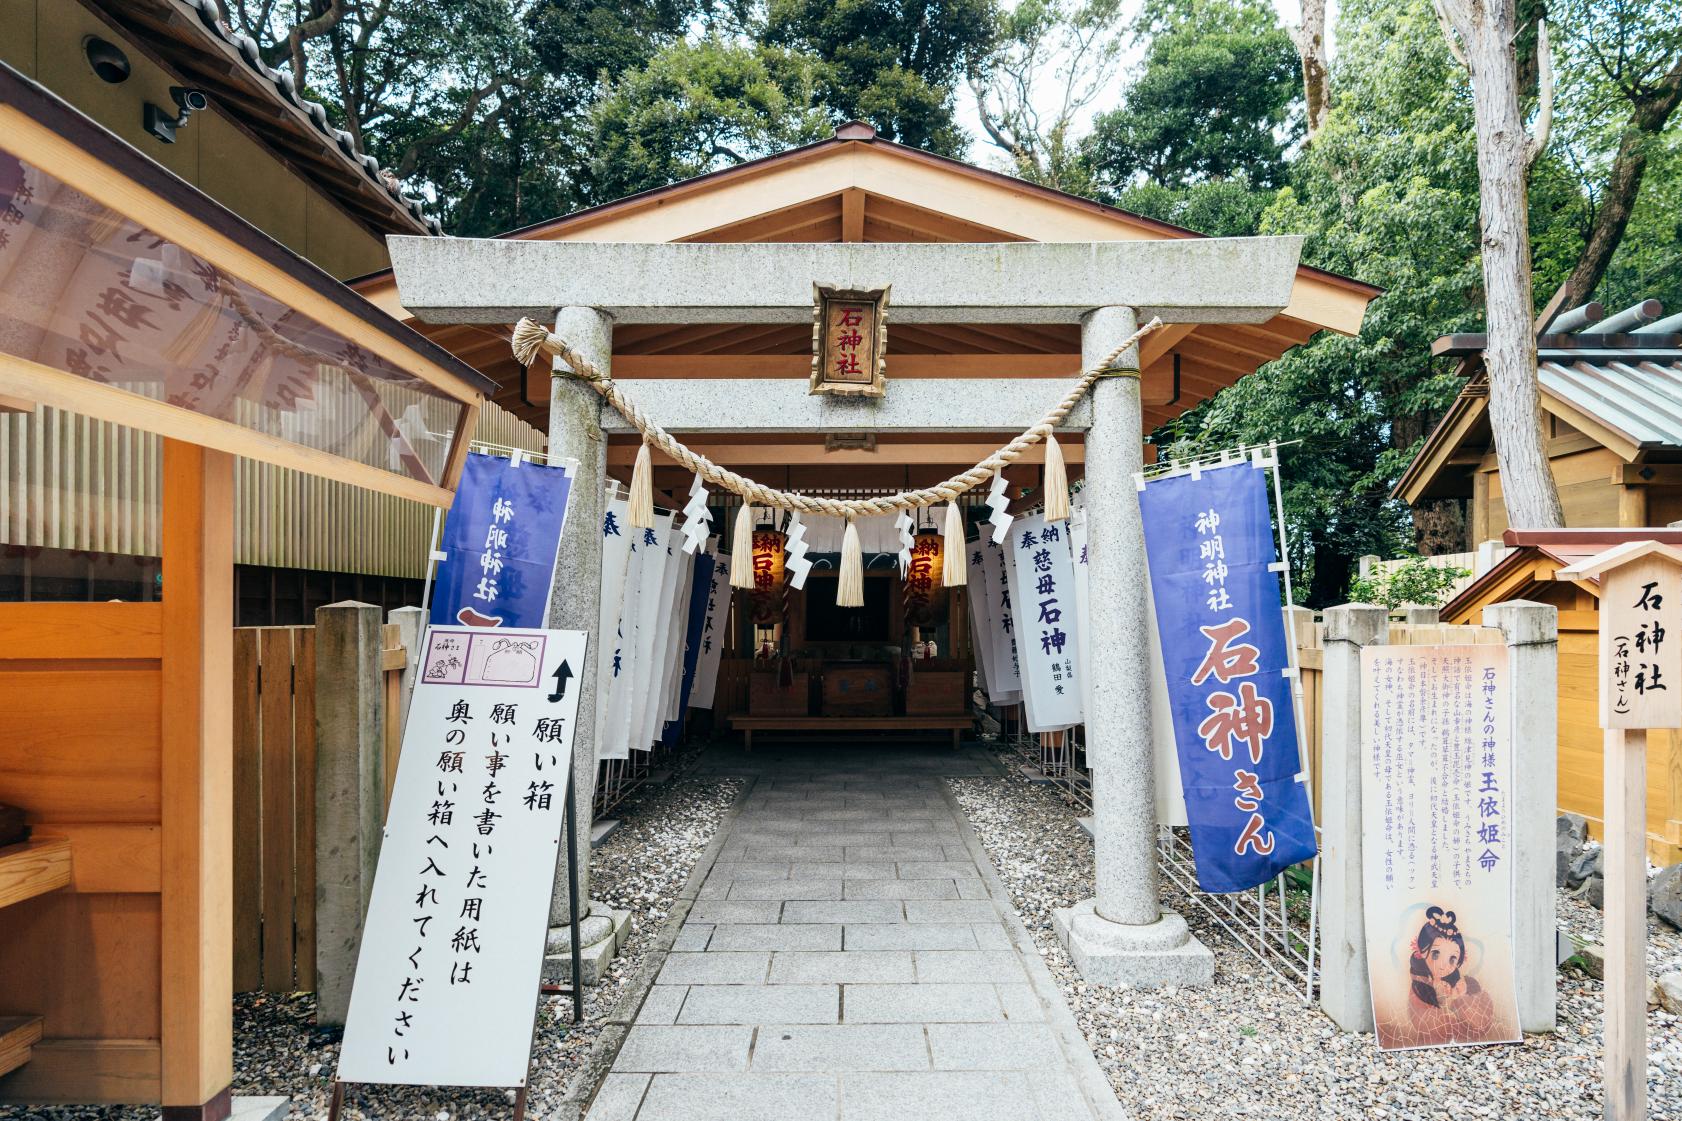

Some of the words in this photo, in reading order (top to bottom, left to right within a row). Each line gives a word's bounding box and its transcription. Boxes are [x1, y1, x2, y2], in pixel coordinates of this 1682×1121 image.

[835, 307, 863, 375] 石神社
[1021, 525, 1060, 550] 奉納
[1194, 508, 1233, 613] 神明神社
[1034, 548, 1066, 656] 慈母石神
[1632, 581, 1667, 696] 石神社
[522, 717, 565, 811] 願い箱
[1192, 617, 1275, 856] 石神さん
[388, 699, 473, 1065] 奥の願い箱へ入れてください
[450, 703, 518, 986] 願い事を書いた用紙は
